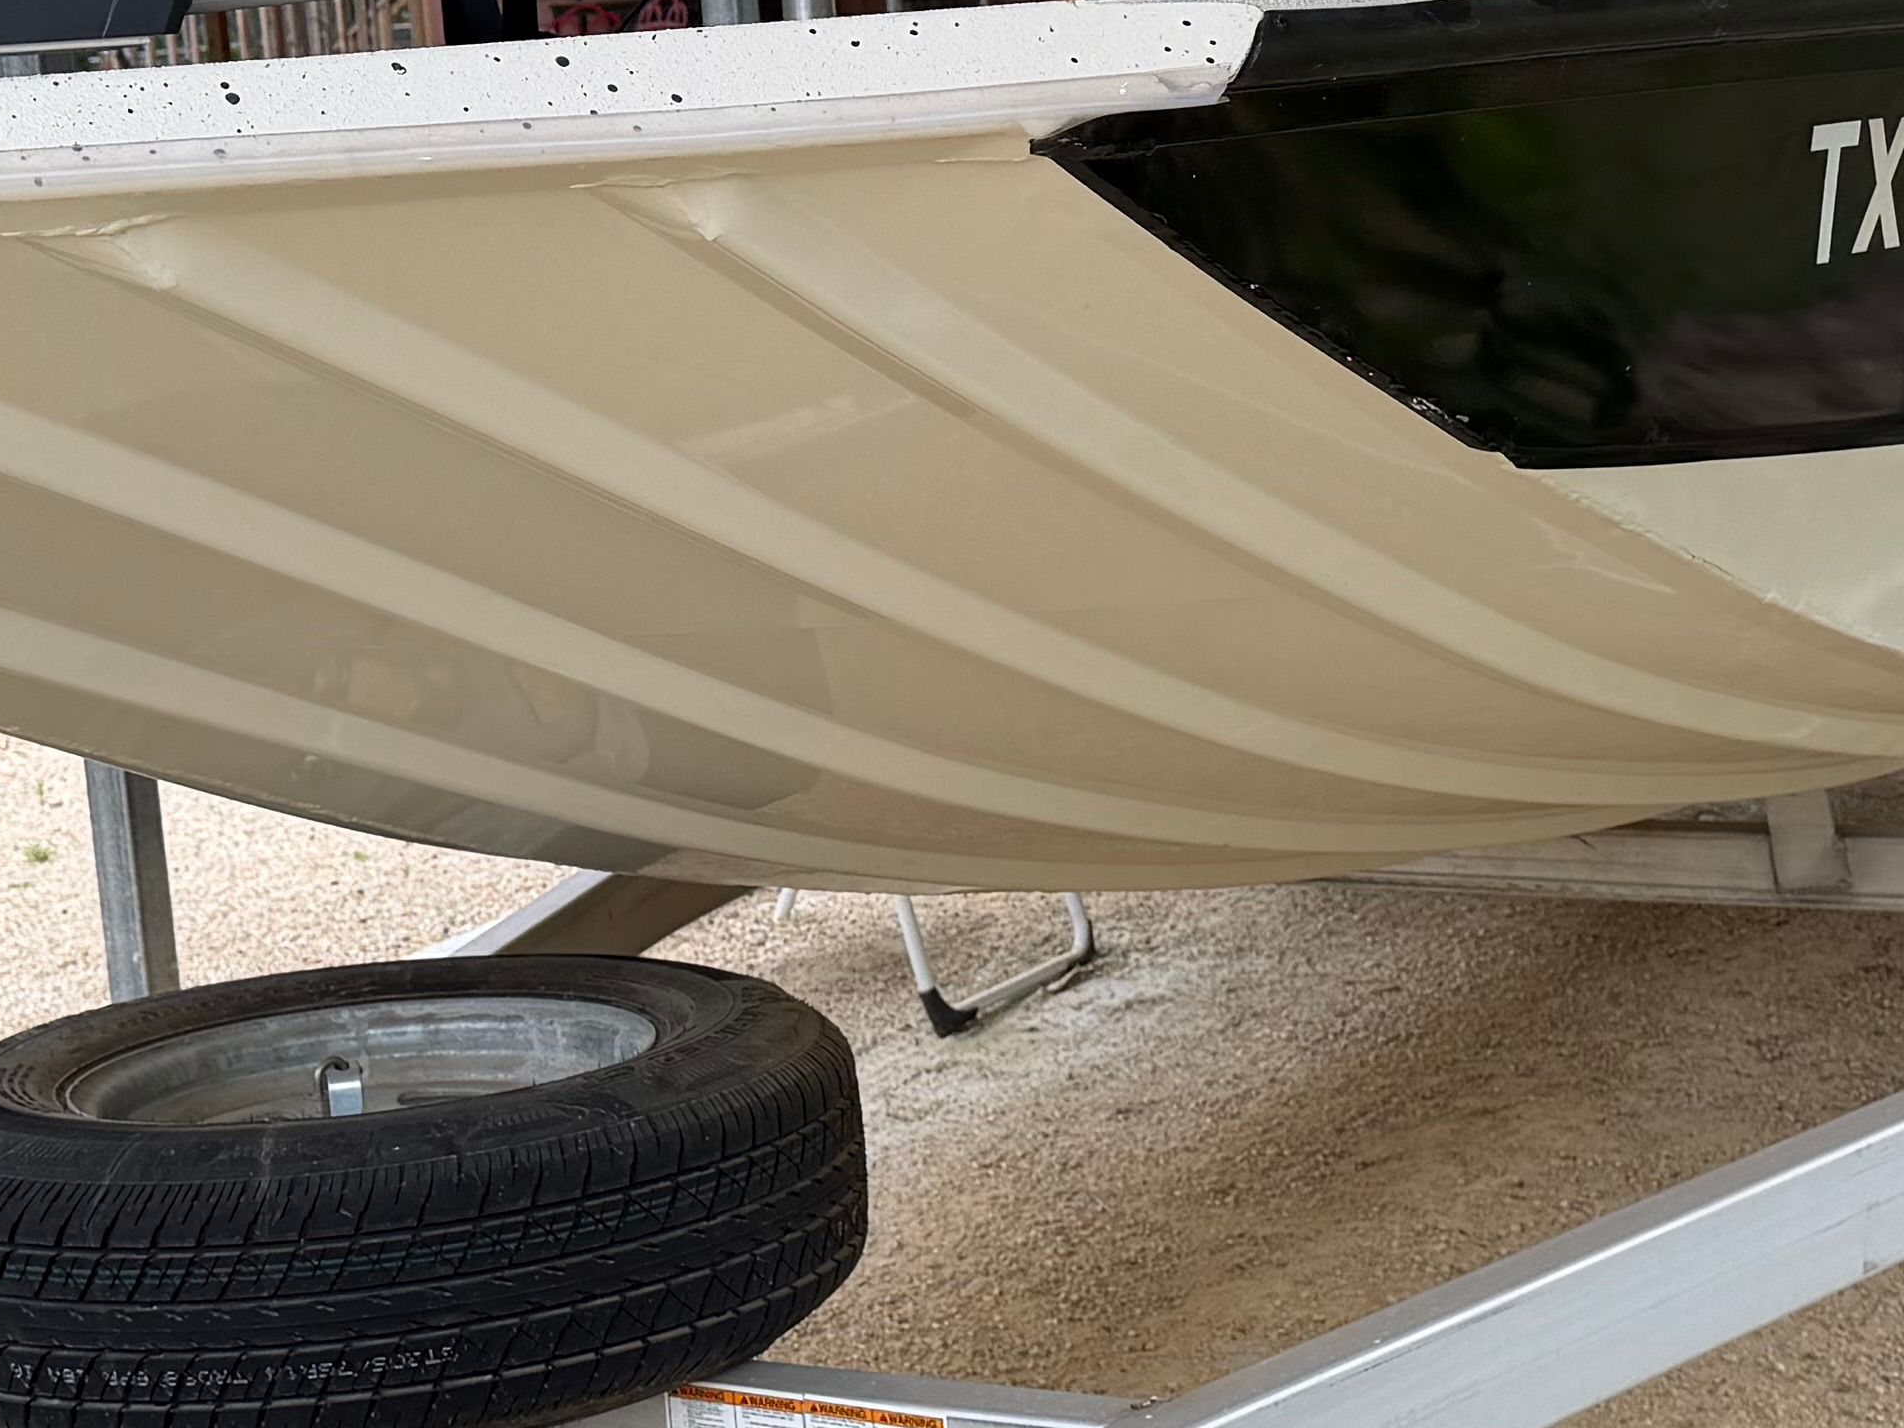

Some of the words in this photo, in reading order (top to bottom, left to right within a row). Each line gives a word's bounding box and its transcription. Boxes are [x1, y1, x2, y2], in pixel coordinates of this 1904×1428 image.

[678, 1385, 725, 1402] WARNING
[749, 1395, 796, 1412] WARNING
[819, 1403, 866, 1420] WARNING
